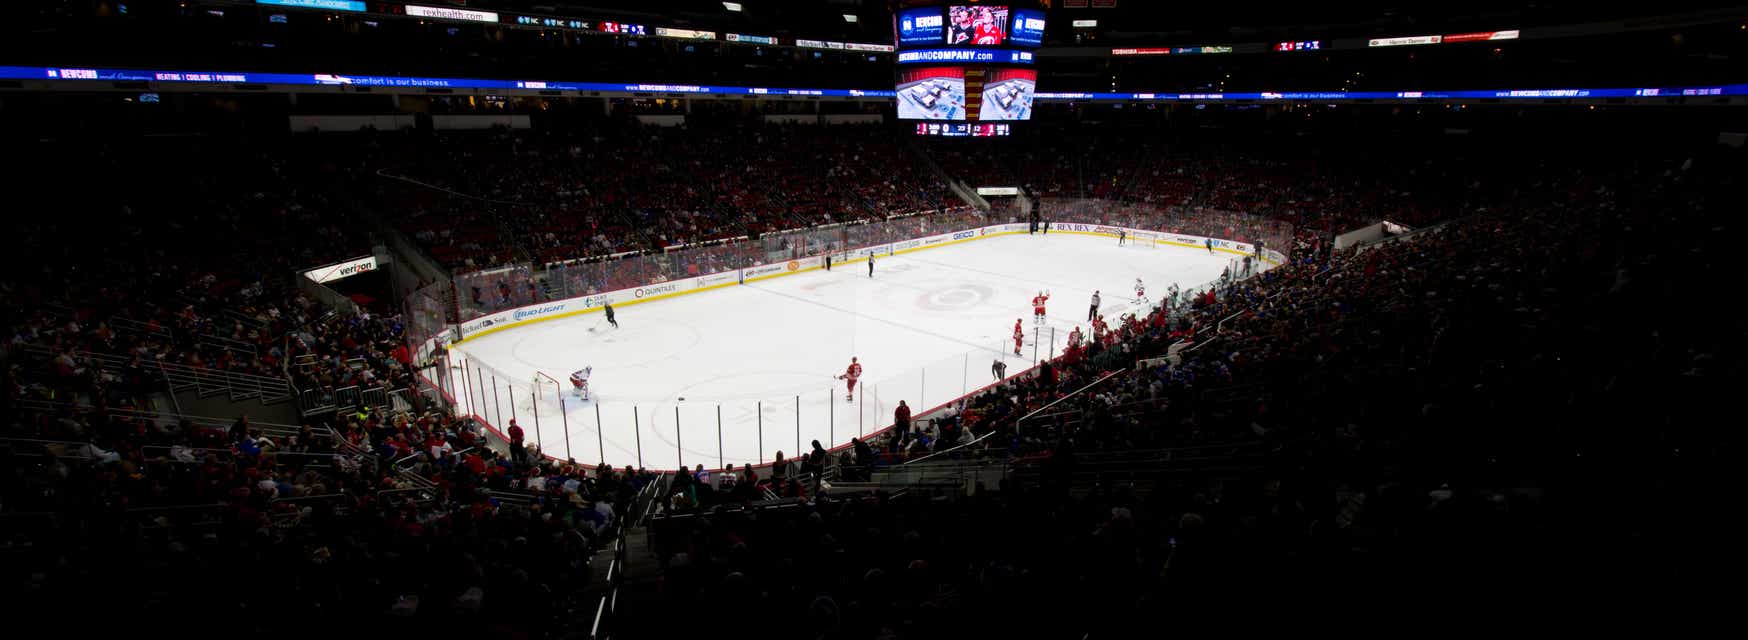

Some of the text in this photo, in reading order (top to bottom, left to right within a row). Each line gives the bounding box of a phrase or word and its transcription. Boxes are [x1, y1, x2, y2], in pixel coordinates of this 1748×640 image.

[423, 8, 484, 21] rexhealth.com
[1057, 223, 1073, 231] REX
[953, 230, 974, 241] GEICO
[340, 261, 372, 276] verizon
[644, 285, 676, 296] QUINTILES
